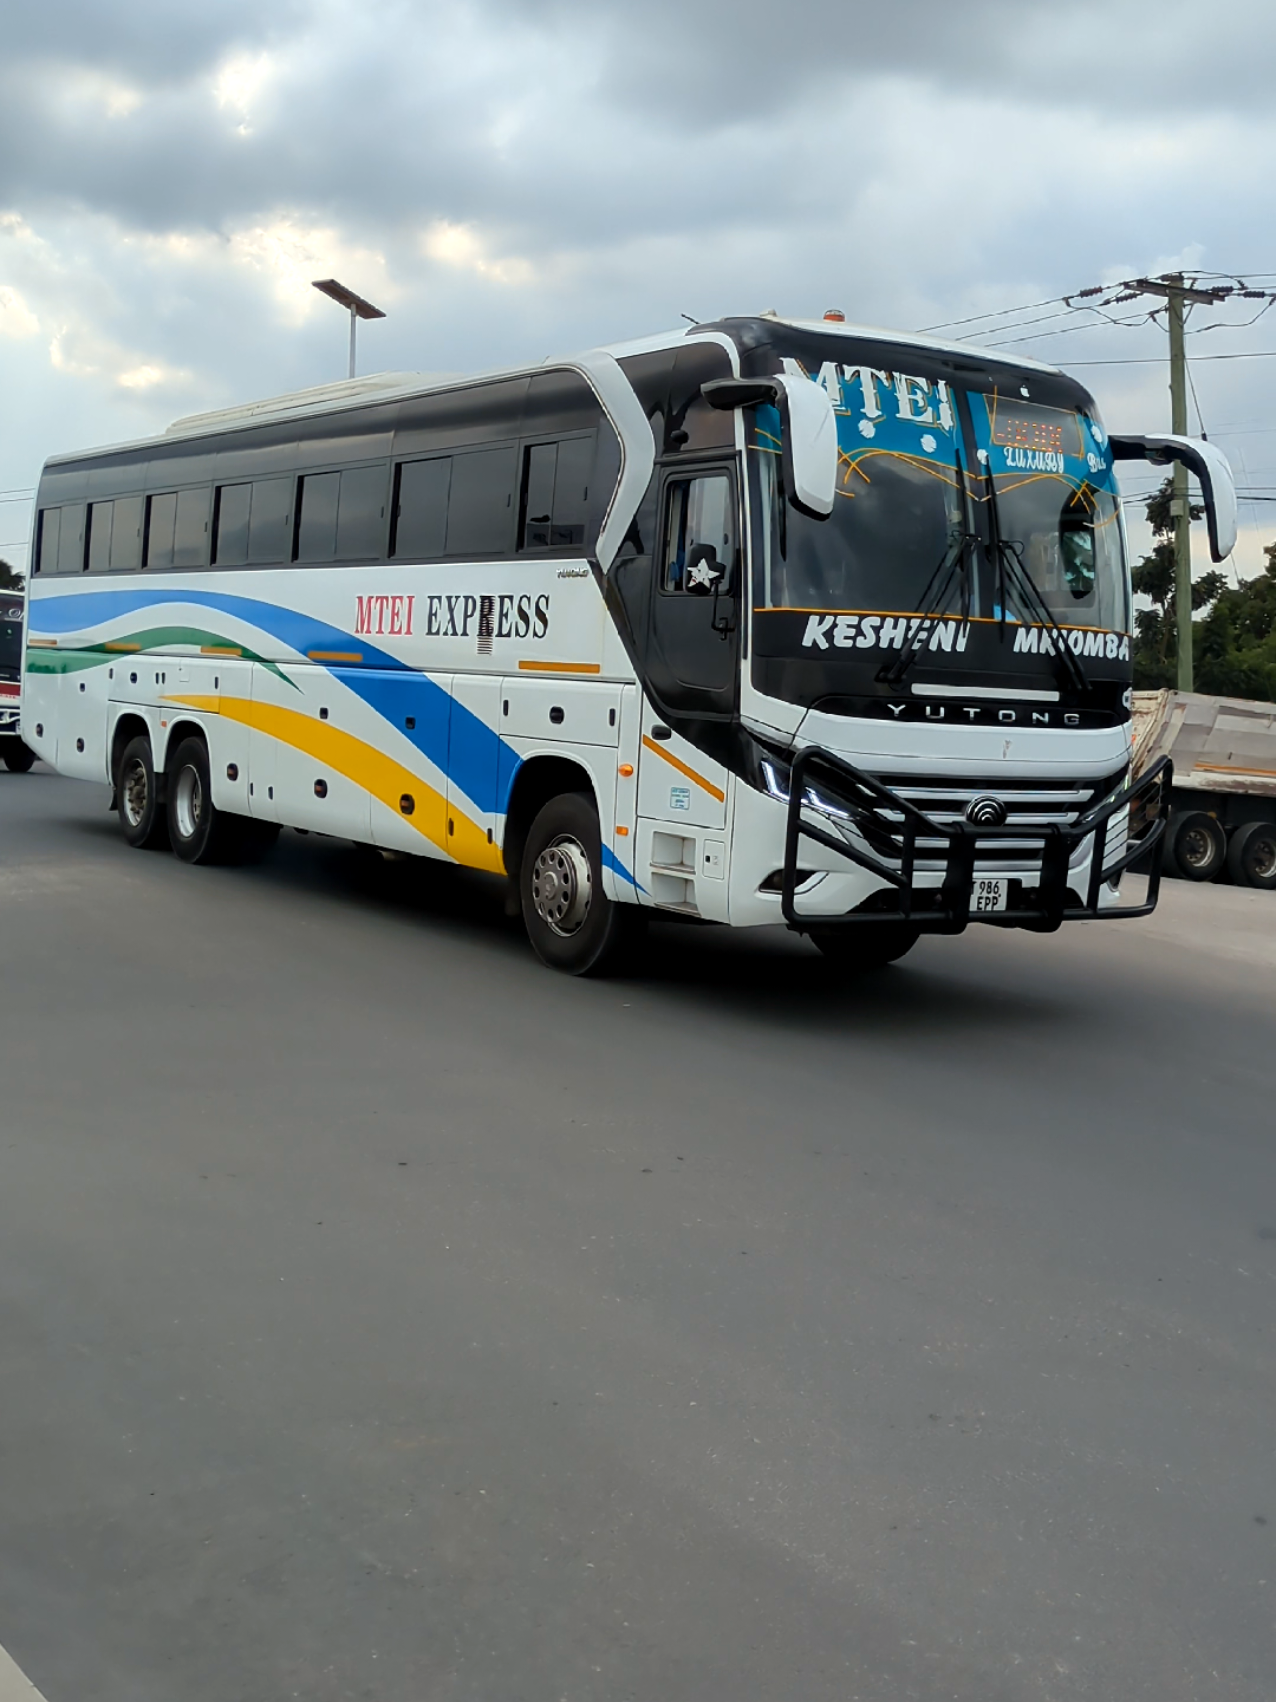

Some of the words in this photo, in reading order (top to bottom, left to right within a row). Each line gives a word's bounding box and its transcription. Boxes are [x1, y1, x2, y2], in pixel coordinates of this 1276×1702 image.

[354, 595, 415, 635] MTEI
[425, 594, 550, 639] EXPRESS
[802, 615, 970, 652] KESHENI
[887, 703, 1080, 725] YUTONG
[979, 881, 999, 895] 986
[977, 896, 998, 911] EPP
